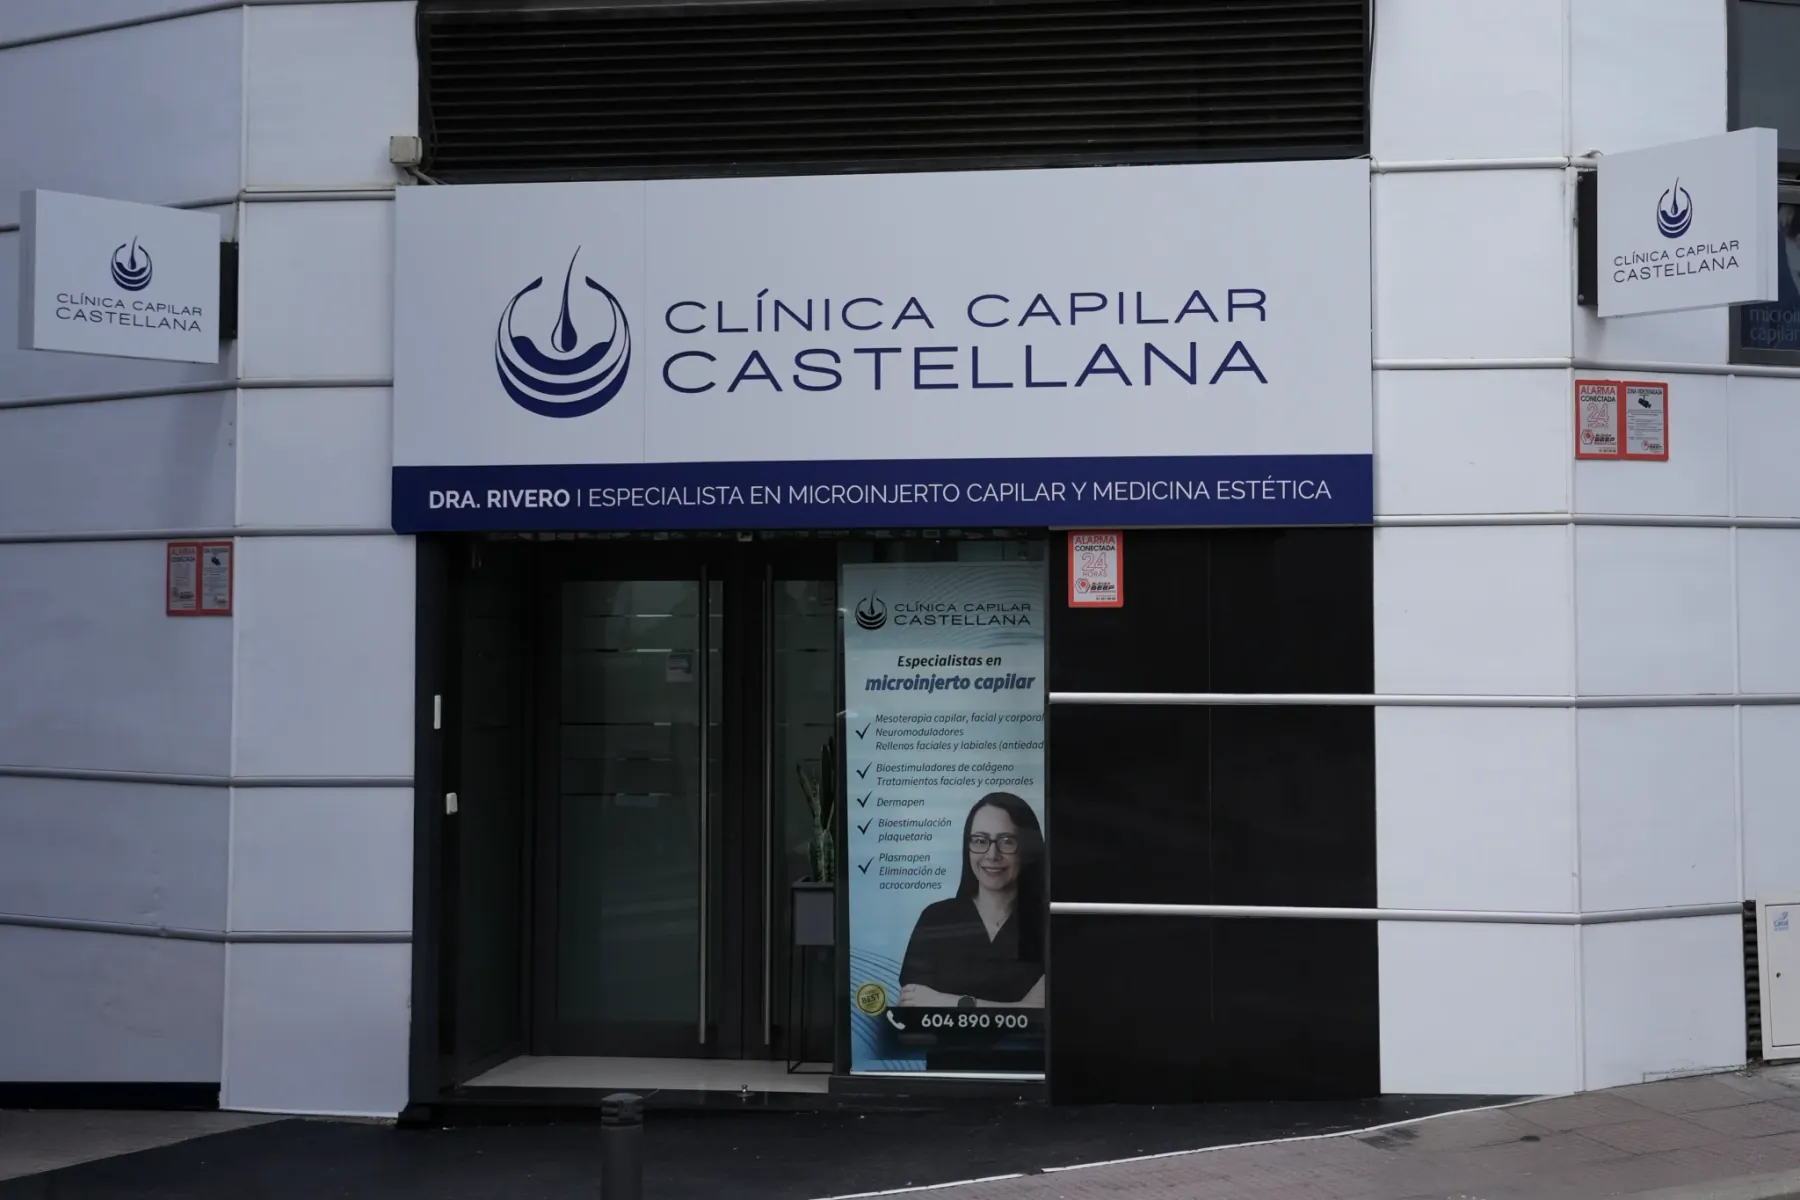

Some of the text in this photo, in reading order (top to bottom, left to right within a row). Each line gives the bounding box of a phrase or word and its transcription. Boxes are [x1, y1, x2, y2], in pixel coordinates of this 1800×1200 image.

[1613, 240, 1740, 267] CLÍNICA CAPILAR
[1613, 256, 1739, 283] CASTELLANA
[56, 292, 203, 317] CLÍNICA CAPILAR
[665, 287, 1267, 334] CLÍNICA CAPILAR
[55, 306, 202, 332] CASTELLANA
[662, 340, 1269, 394] CASTELLANA
[1580, 386, 1616, 395] ALARMA
[1587, 403, 1610, 422] 24
[429, 490, 481, 509] DRA.
[487, 489, 570, 508] RIVERO
[588, 486, 745, 507] ESPECIALISTA
[751, 484, 781, 505] EN
[789, 483, 961, 506] MICROINJERTO
[967, 482, 1066, 503] CAPILAR
[1071, 481, 1087, 502] Y
[1093, 480, 1210, 502] MEDICINA
[1216, 475, 1332, 501] ESTÉTICA
[1075, 536, 1116, 545] ALARMA
[1082, 552, 1108, 572] 24
[894, 602, 1032, 612] CLÍNICA CAPILAR
[894, 614, 1032, 626] CASTELLANA
[897, 654, 1002, 669] Especialistas en
[865, 673, 1036, 694] microinjerto capilar
[875, 713, 932, 725] Mesoterapia
[933, 713, 968, 725] capilar,
[971, 713, 996, 722] facial
[998, 714, 1004, 724] y
[875, 727, 964, 737] Neuromoduladores
[875, 740, 914, 750] Rellenos
[914, 740, 951, 751] faciales
[952, 743, 960, 752] y
[960, 740, 997, 750] labiales
[876, 762, 1014, 774] Bioestimuladores de colágeno
[876, 776, 1034, 788] Tratamientos faciales y corporales
[876, 798, 925, 808] Dermapen
[878, 818, 952, 828] Bioestimulación
[878, 832, 933, 842] plaquetaria
[879, 853, 931, 864] Plasmapen
[879, 866, 947, 876] Eliminación de
[879, 880, 942, 890] acrocordones
[921, 1014, 1028, 1028] 604 890 900
